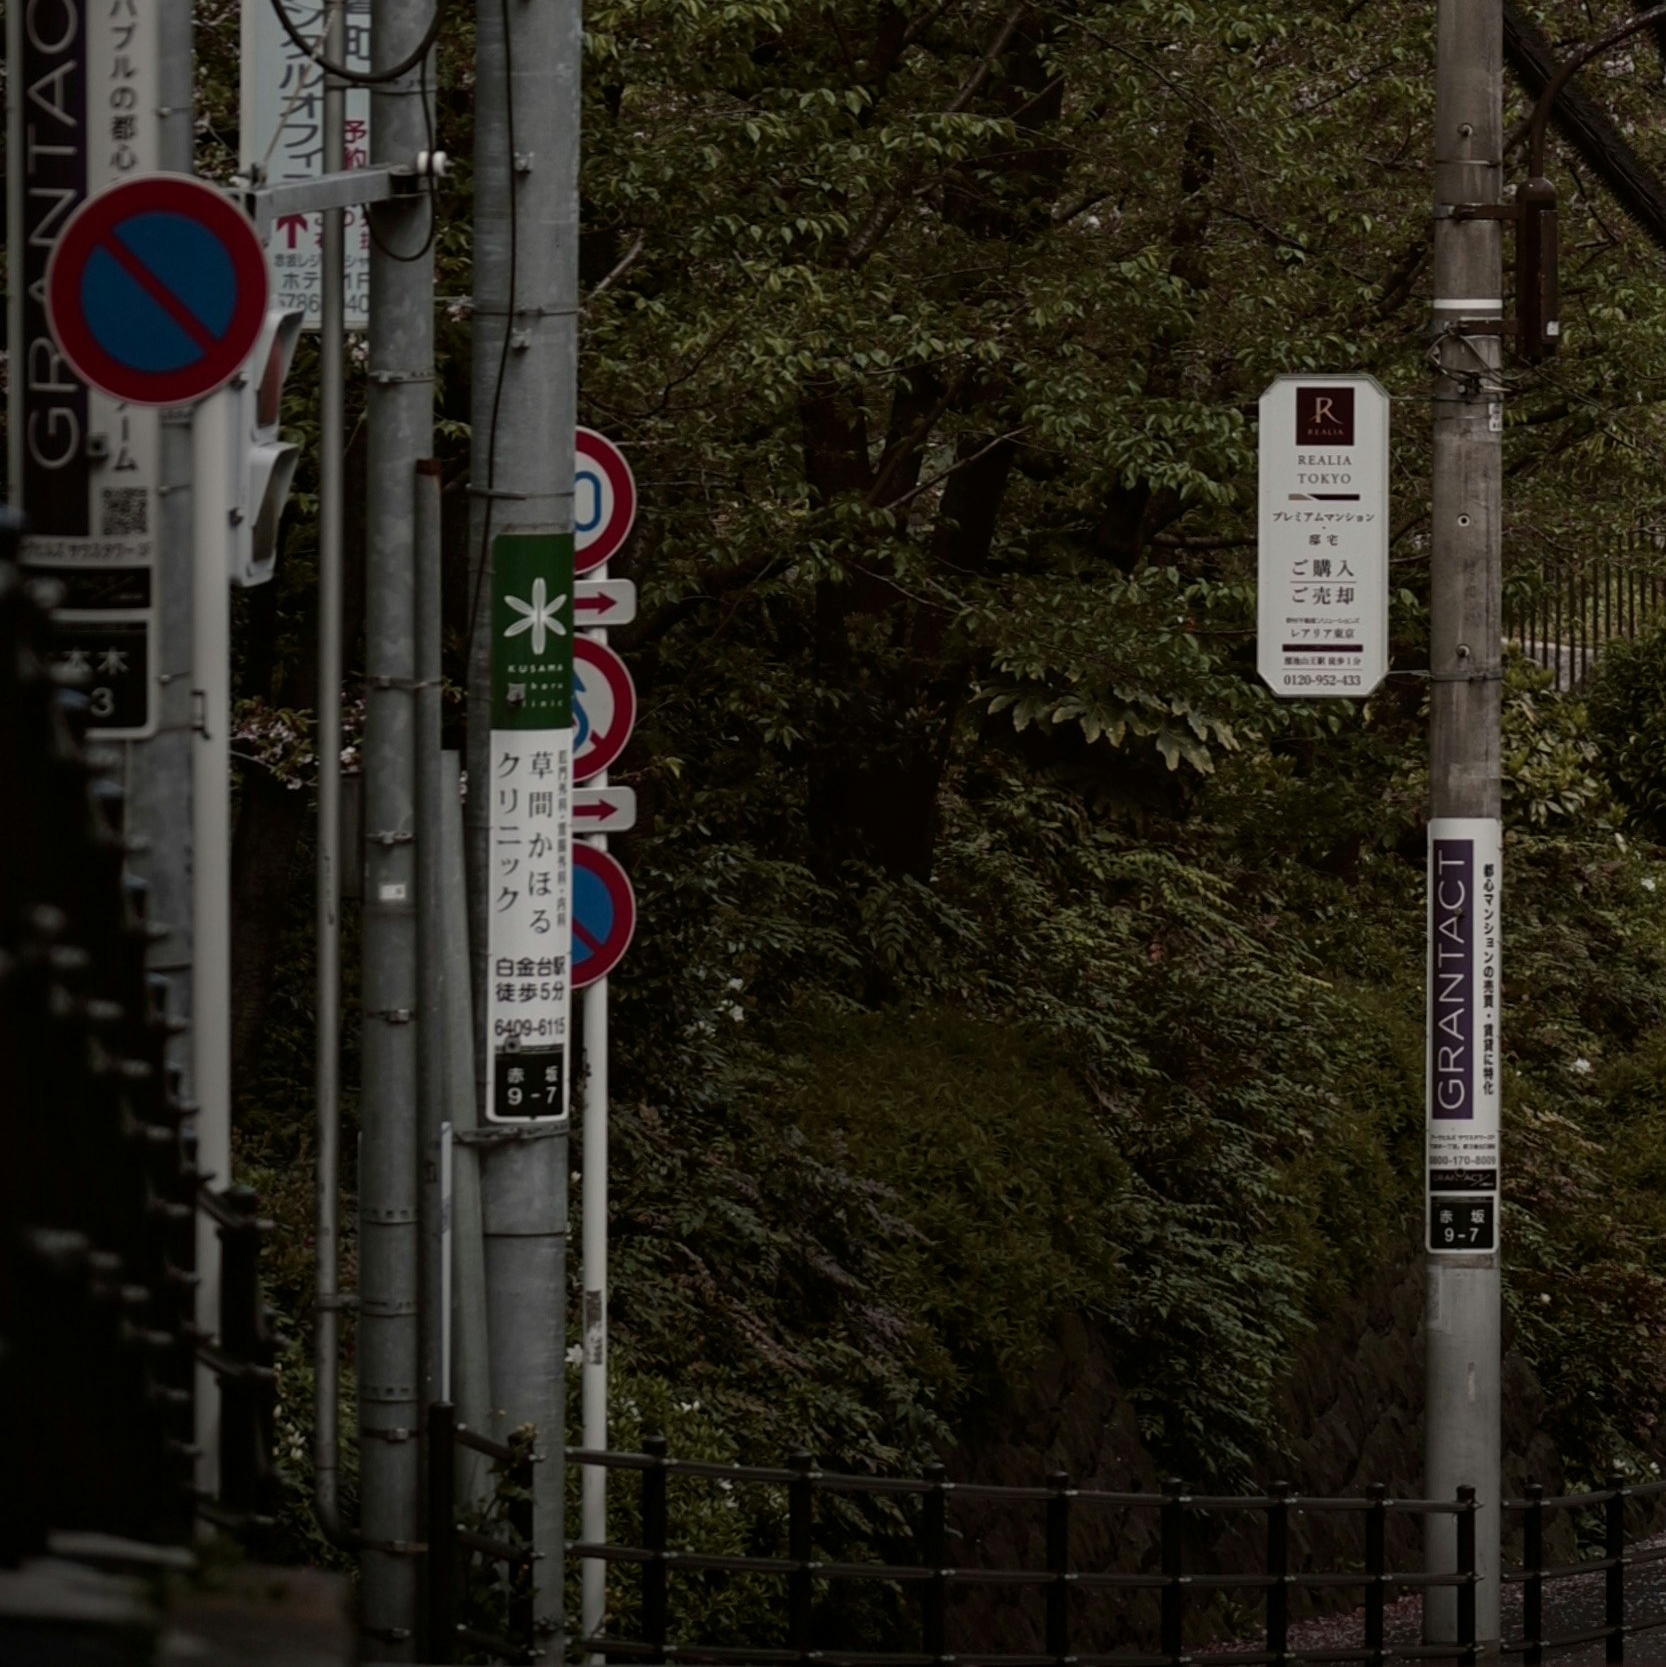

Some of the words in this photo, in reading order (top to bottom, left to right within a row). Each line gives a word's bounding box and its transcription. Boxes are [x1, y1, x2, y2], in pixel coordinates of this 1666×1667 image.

[1307, 428, 1345, 436] REALIA
[1298, 455, 1352, 466] REALIA
[1297, 473, 1352, 484] TOKYO
[1272, 512, 1375, 523] プレミアムマンション
[1292, 559, 1355, 579] ご購入
[1292, 586, 1355, 606] ご売却
[1291, 628, 1355, 639] レアリア東京
[1284, 675, 1361, 686] 0120-952-433
[497, 752, 520, 913] クリニック
[528, 751, 553, 934] 草間かほる
[496, 955, 566, 977] 白金台駅
[1437, 850, 1466, 1110] GRANTACT
[496, 982, 564, 1003] 徒歩5分
[495, 1017, 566, 1037] 6409-6115
[506, 1086, 558, 1106] 9-7
[1443, 1227, 1480, 1244] 9-7
